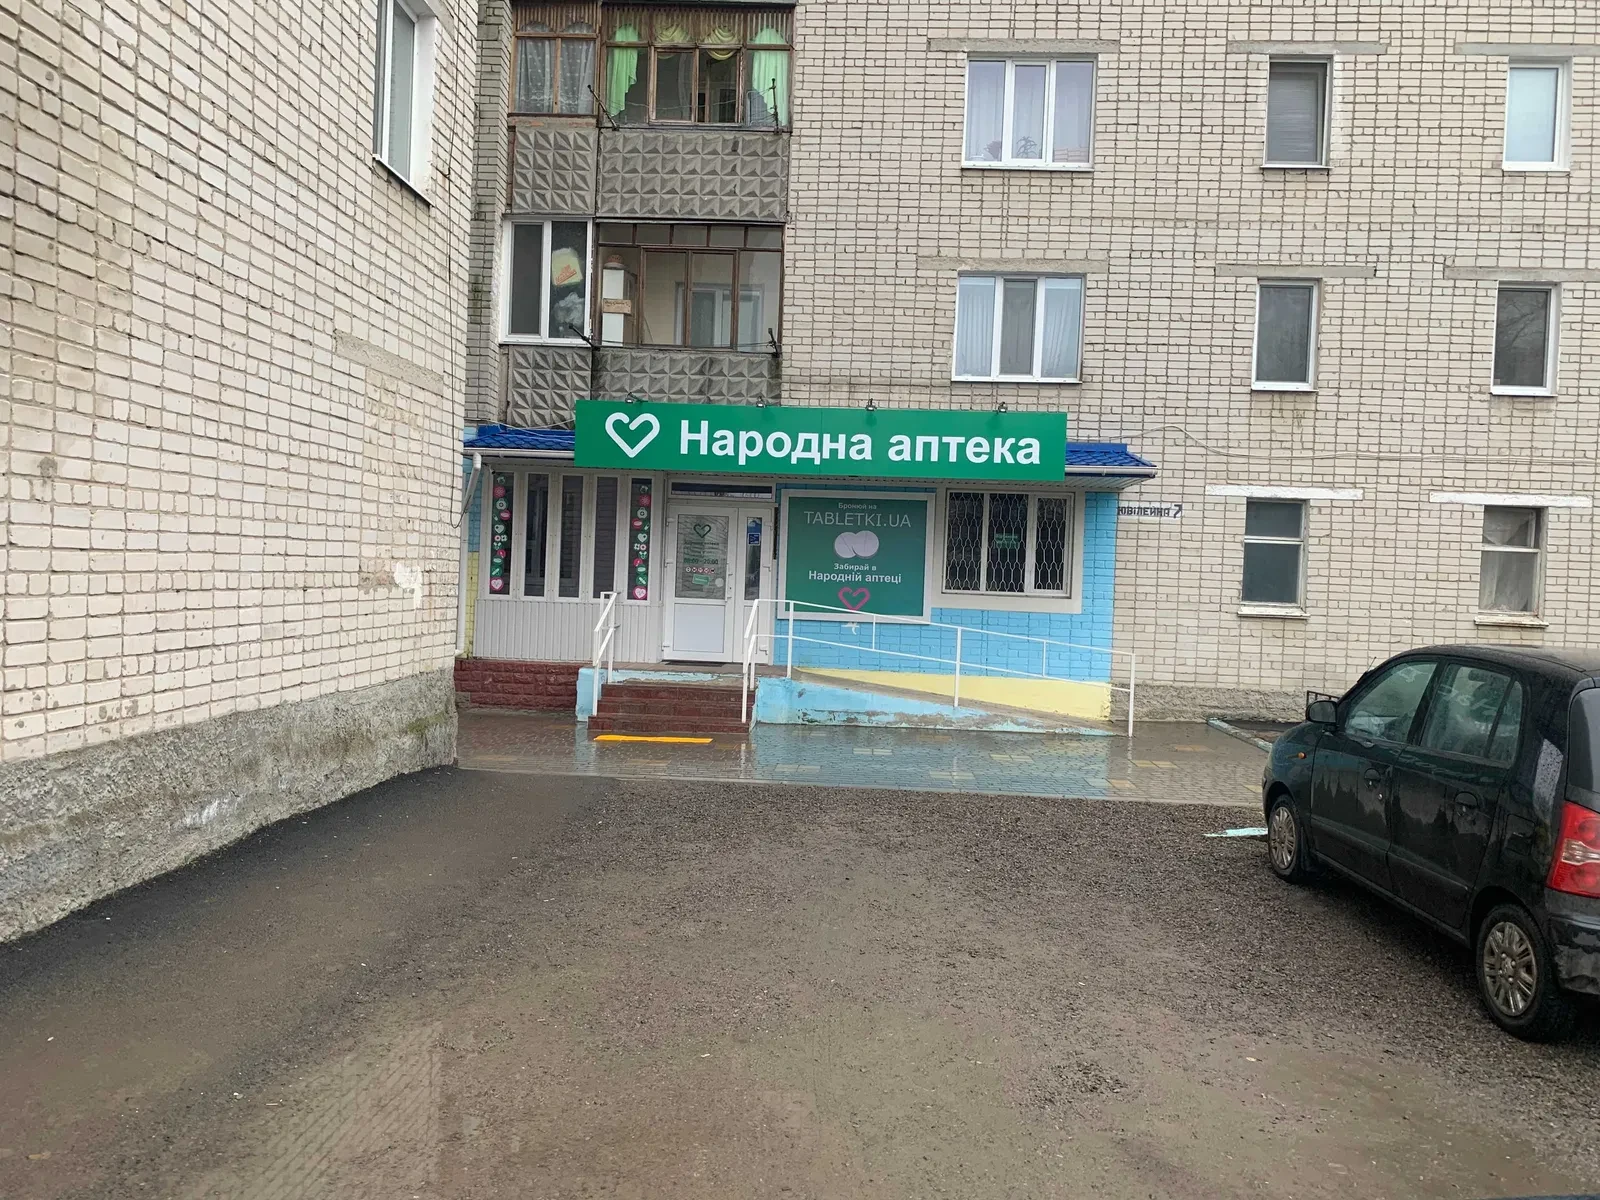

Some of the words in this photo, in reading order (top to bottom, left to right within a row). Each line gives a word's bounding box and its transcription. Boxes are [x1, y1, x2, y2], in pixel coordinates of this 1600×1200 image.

[680, 420, 872, 465] Народна
[888, 435, 1041, 465] аптека
[1173, 504, 1182, 518] 7
[804, 511, 911, 528] TABLETKI.UA
[833, 563, 869, 571] Забирай
[808, 570, 862, 583] Народній
[865, 573, 902, 584] аптеці
